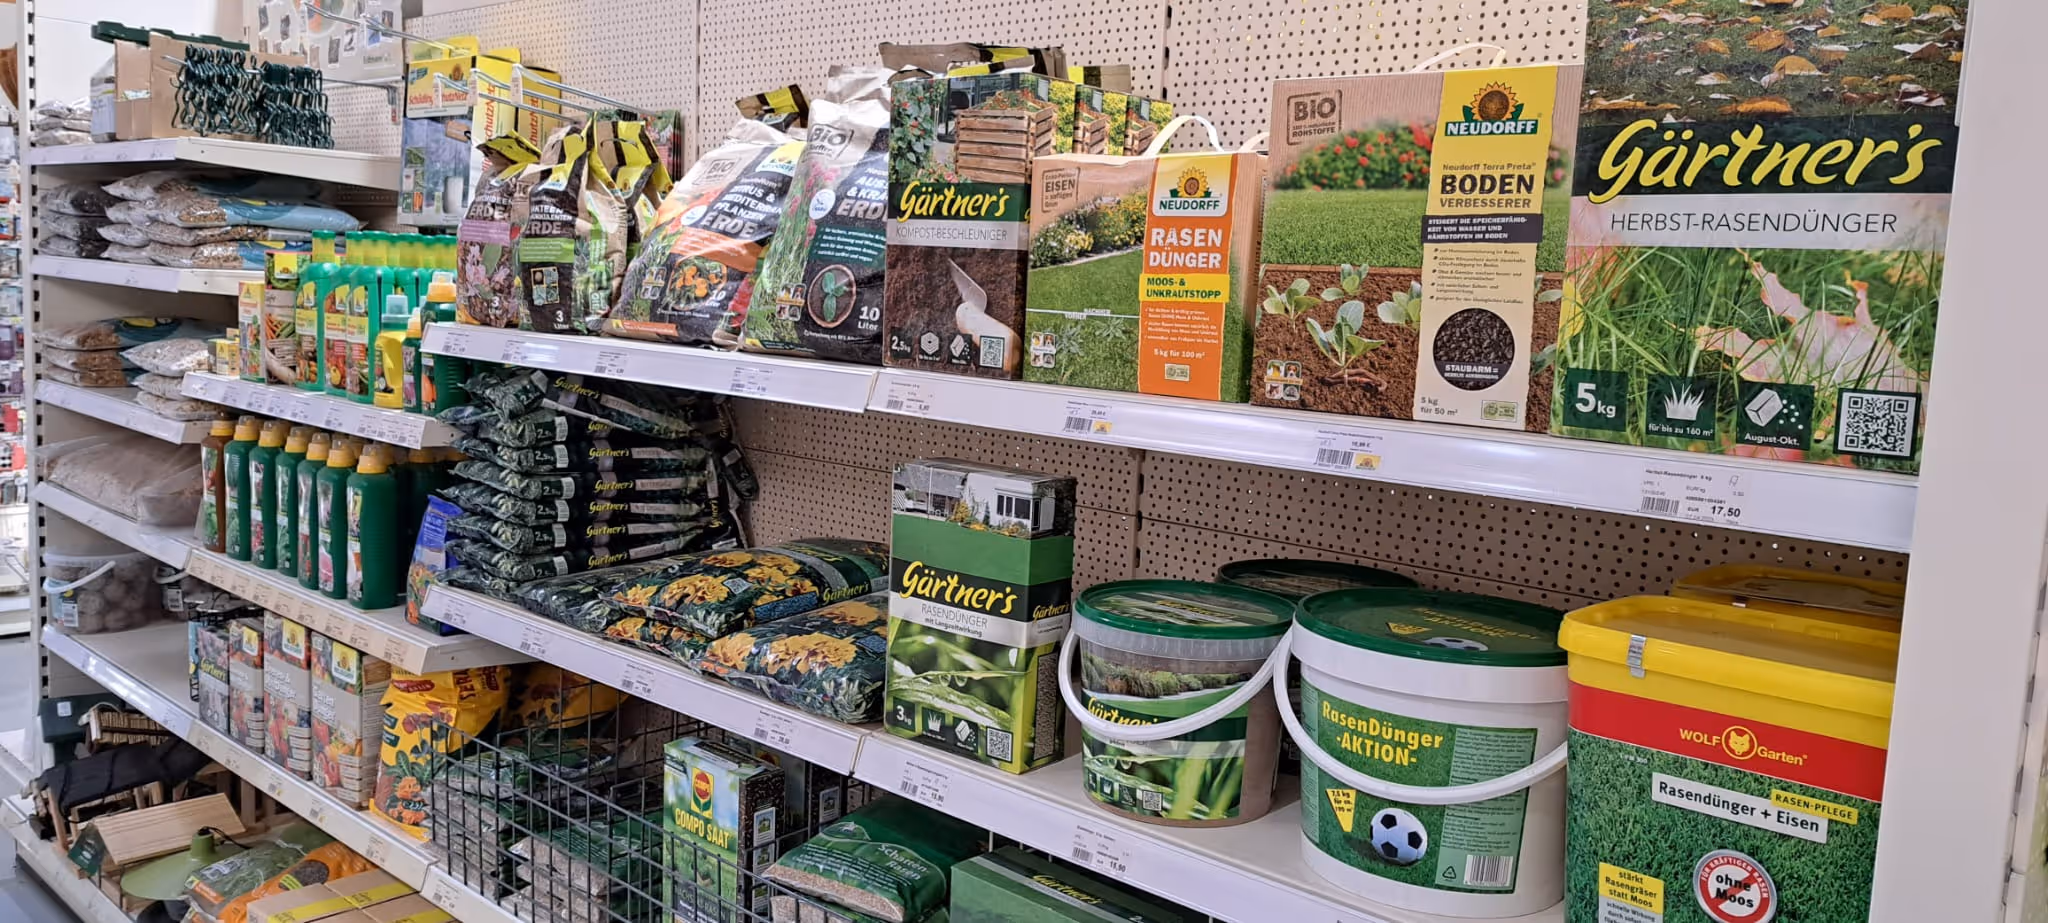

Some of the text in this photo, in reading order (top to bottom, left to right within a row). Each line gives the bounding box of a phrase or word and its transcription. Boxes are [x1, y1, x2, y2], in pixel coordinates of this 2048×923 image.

[1292, 126, 1337, 138] ROHSTOFFE
[1445, 120, 1537, 135] NEUDORFF
[1442, 163, 1480, 171] Neudorff
[1482, 162, 1505, 171] Terra
[1588, 118, 1943, 204] Gärtner's
[846, 186, 858, 197] &
[1045, 179, 1076, 193] EISEN
[1440, 173, 1535, 196] BODEN
[765, 191, 775, 203] &
[896, 181, 1010, 223] Gärtner's
[1159, 200, 1221, 211] NEUDORFF
[1439, 196, 1532, 209] VERBESSERER
[469, 203, 507, 220] ERDE
[836, 199, 888, 222] ERD
[700, 212, 761, 237] ERDE
[1611, 208, 1898, 234] HERBST-RASENDÜNGER
[896, 224, 1008, 242] KOMPOST-BESCHLEUNIGER
[1151, 228, 1224, 248] RASEN
[1149, 245, 1222, 268] DÜNGER
[1179, 277, 1186, 287] &
[491, 295, 500, 307] 3
[711, 290, 726, 300] 10
[1146, 288, 1222, 300] UNKRAUTSTOPP
[555, 309, 564, 323] 3
[859, 305, 880, 322] 10
[857, 321, 879, 332] Liter
[1153, 348, 1159, 356] 5
[1159, 348, 1168, 358] kg
[1169, 348, 1180, 357] für
[1181, 350, 1195, 358] 100
[1445, 364, 1492, 374] STAUBARM
[553, 376, 600, 399] Gärtner's
[1420, 396, 1439, 408] 5 kg
[1420, 405, 1432, 415] für
[1434, 407, 1446, 416] 50
[1648, 423, 1660, 433] für
[1674, 426, 1684, 434] zu
[1686, 428, 1701, 436] 160
[1743, 432, 1801, 447] August-Okt.
[588, 447, 630, 460] Gärtner's
[594, 479, 634, 493] Gärtner's
[589, 501, 629, 514] Gärtner's
[1711, 505, 1742, 519] 17,50
[586, 525, 626, 538] Gärtner's
[587, 552, 628, 569] Gärtner's
[822, 581, 870, 605] Gärtner's
[898, 561, 1018, 615] Gärtner's
[921, 602, 988, 629] RASENDÜNGER
[924, 617, 982, 639] mit Langzeitwirkung
[1322, 700, 1444, 751] RasenDünger
[1678, 728, 1721, 747] WOLF
[1336, 730, 1418, 767] -AKTION-
[1342, 790, 1351, 799] kg
[1658, 781, 1756, 818] Rasendünger
[1775, 809, 1820, 834] Eisen
[1774, 793, 1855, 821] RASEN-PFLEGE
[674, 806, 730, 849] COMPO SAAT
[887, 860, 922, 881] Rasen
[1618, 870, 1644, 885] stärkt
[1032, 873, 1105, 906] Gärtner's
[1605, 876, 1658, 899] Rasengräser
[1715, 873, 1752, 892] ohne
[1608, 889, 1653, 909] statt Moos
[1715, 887, 1754, 909] Moos
